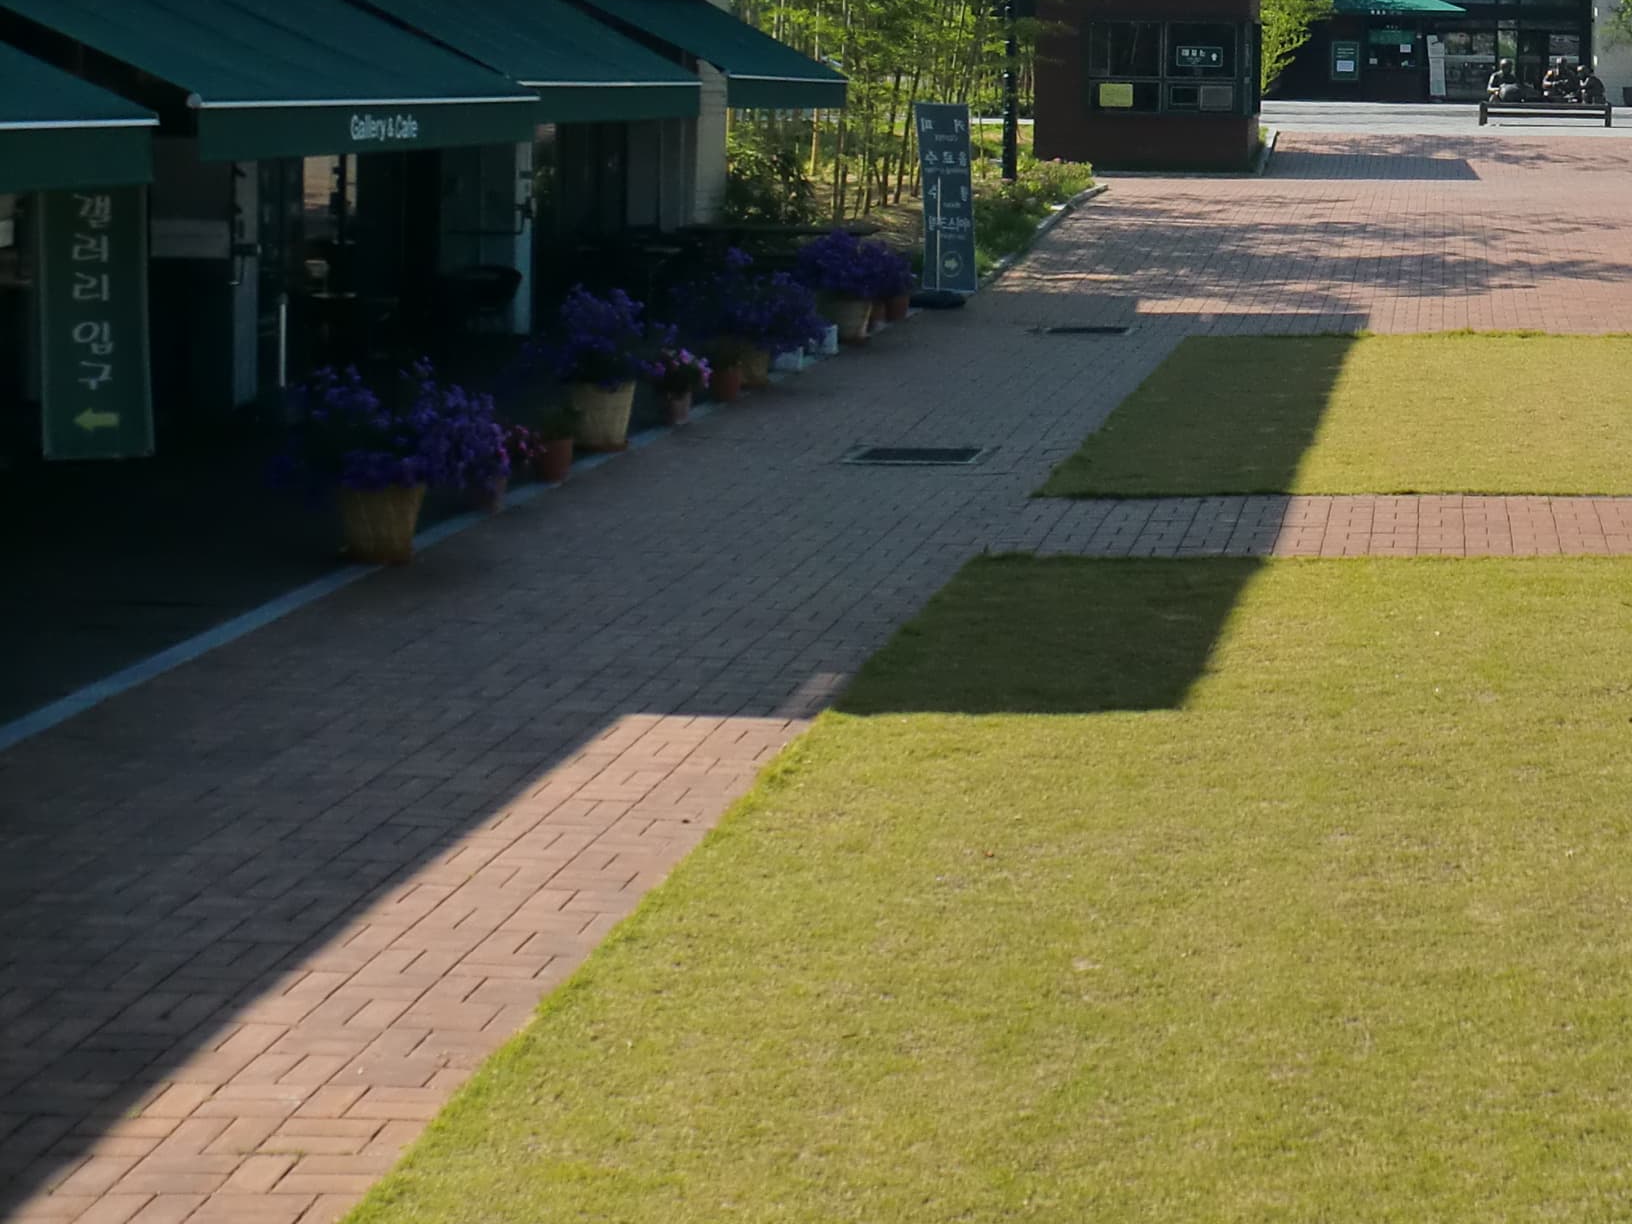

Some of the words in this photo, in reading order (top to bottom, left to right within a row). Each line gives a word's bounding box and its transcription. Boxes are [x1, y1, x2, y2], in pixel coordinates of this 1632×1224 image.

[350, 113, 386, 142] Gallery
[387, 116, 395, 137] &
[395, 113, 419, 139] Cafe
[71, 320, 115, 391] 입구
